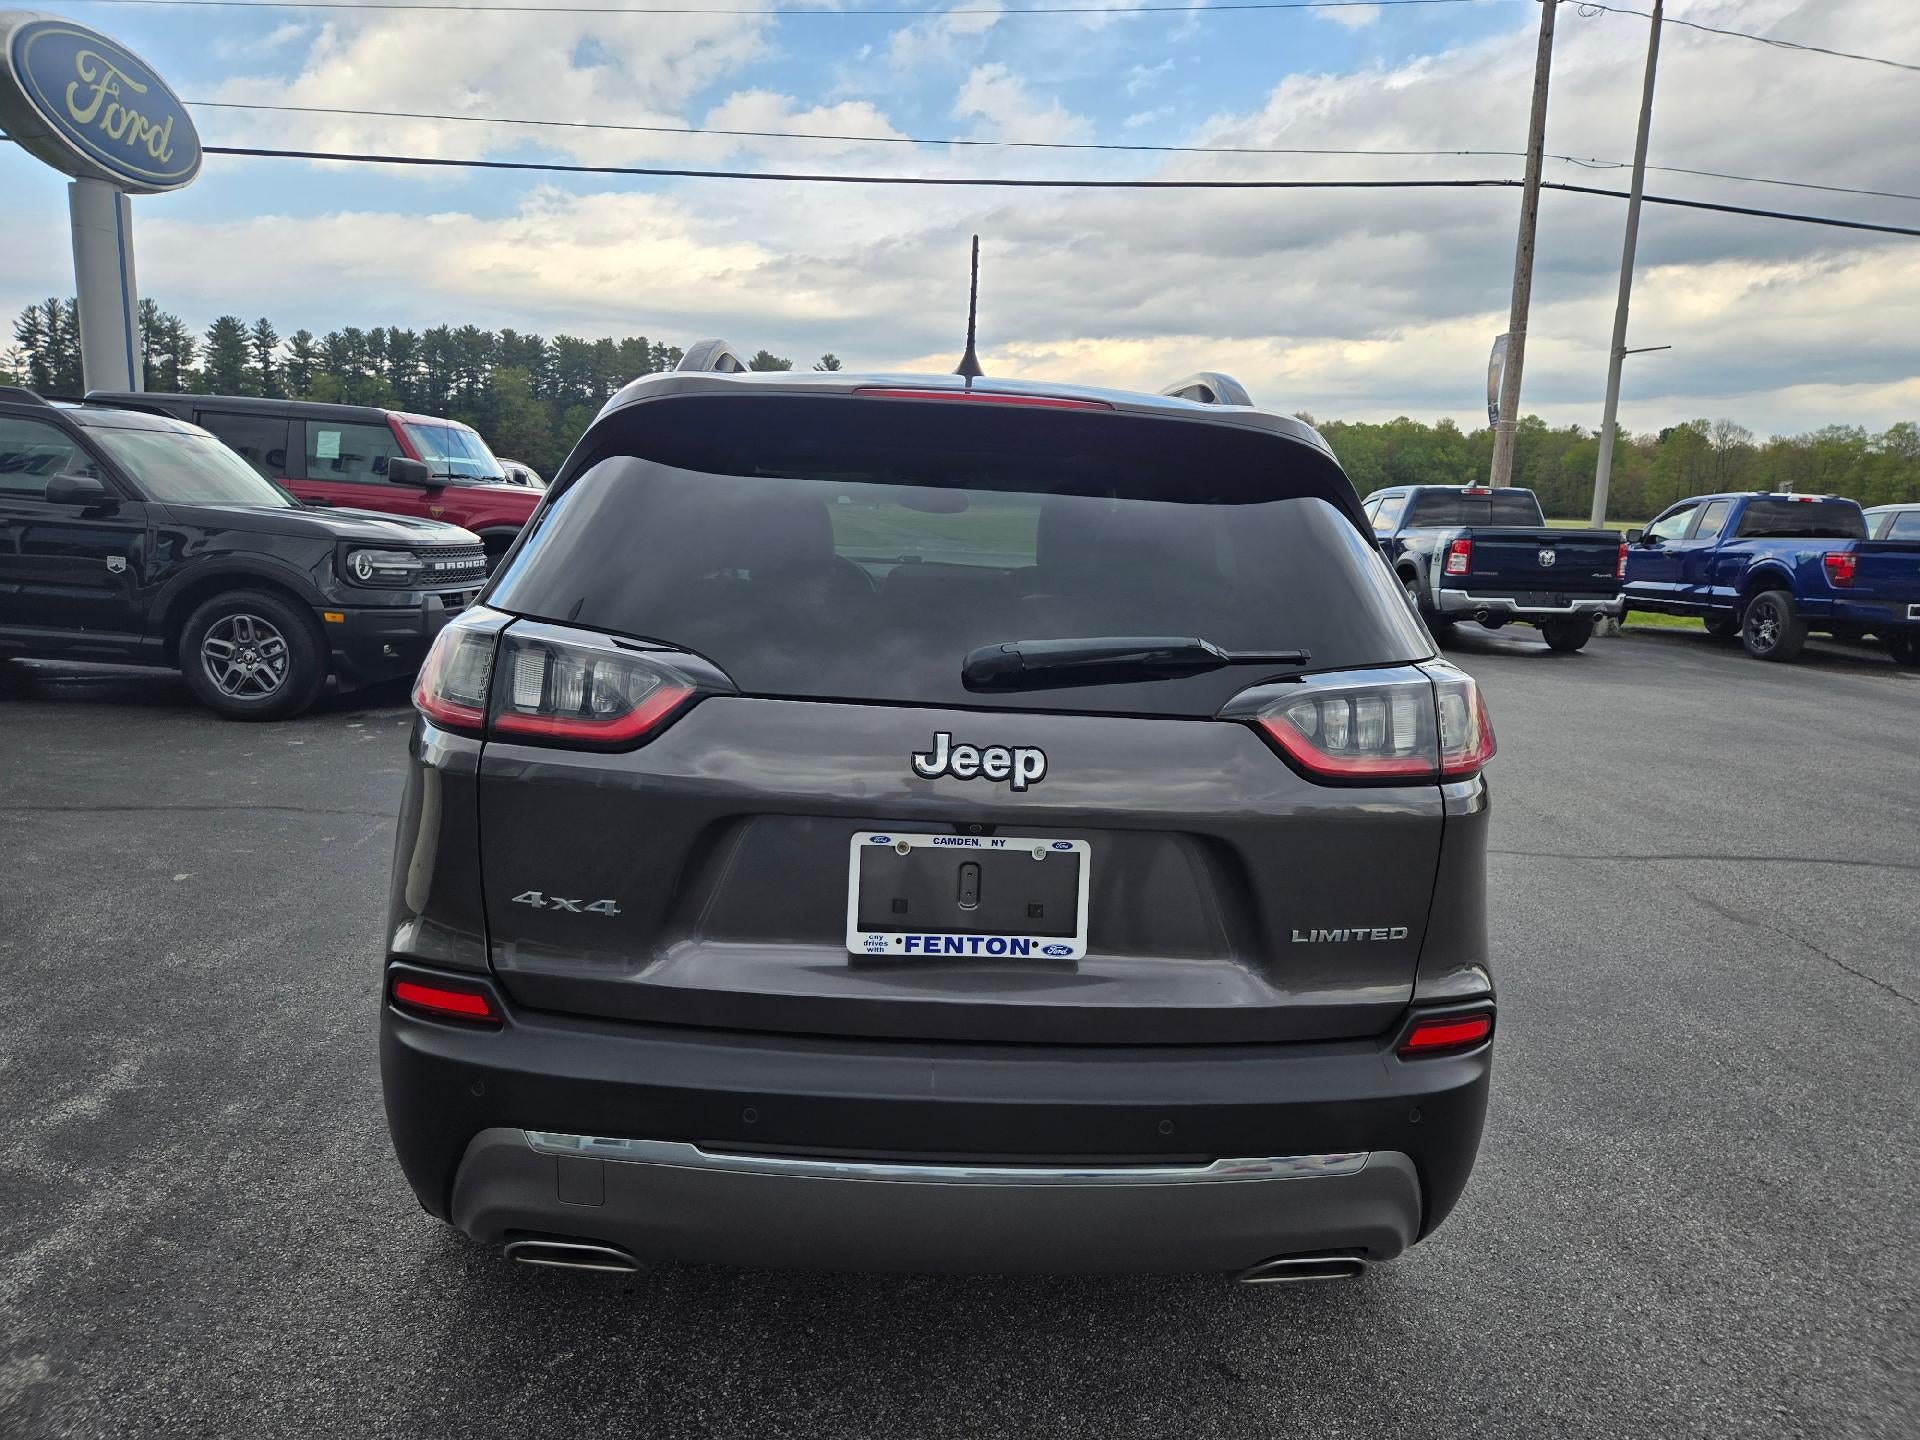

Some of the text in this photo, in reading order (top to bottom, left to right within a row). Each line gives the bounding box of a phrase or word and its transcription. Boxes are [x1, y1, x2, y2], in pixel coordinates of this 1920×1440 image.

[66, 50, 174, 164] Ford
[435, 560, 486, 570] BRONCO
[911, 732, 1048, 792] Jeep
[933, 837, 1006, 848] CAMDEN, NY
[1292, 927, 1408, 942] LIMITED
[904, 936, 1030, 955] FENTON
[1046, 945, 1069, 955] Ford
